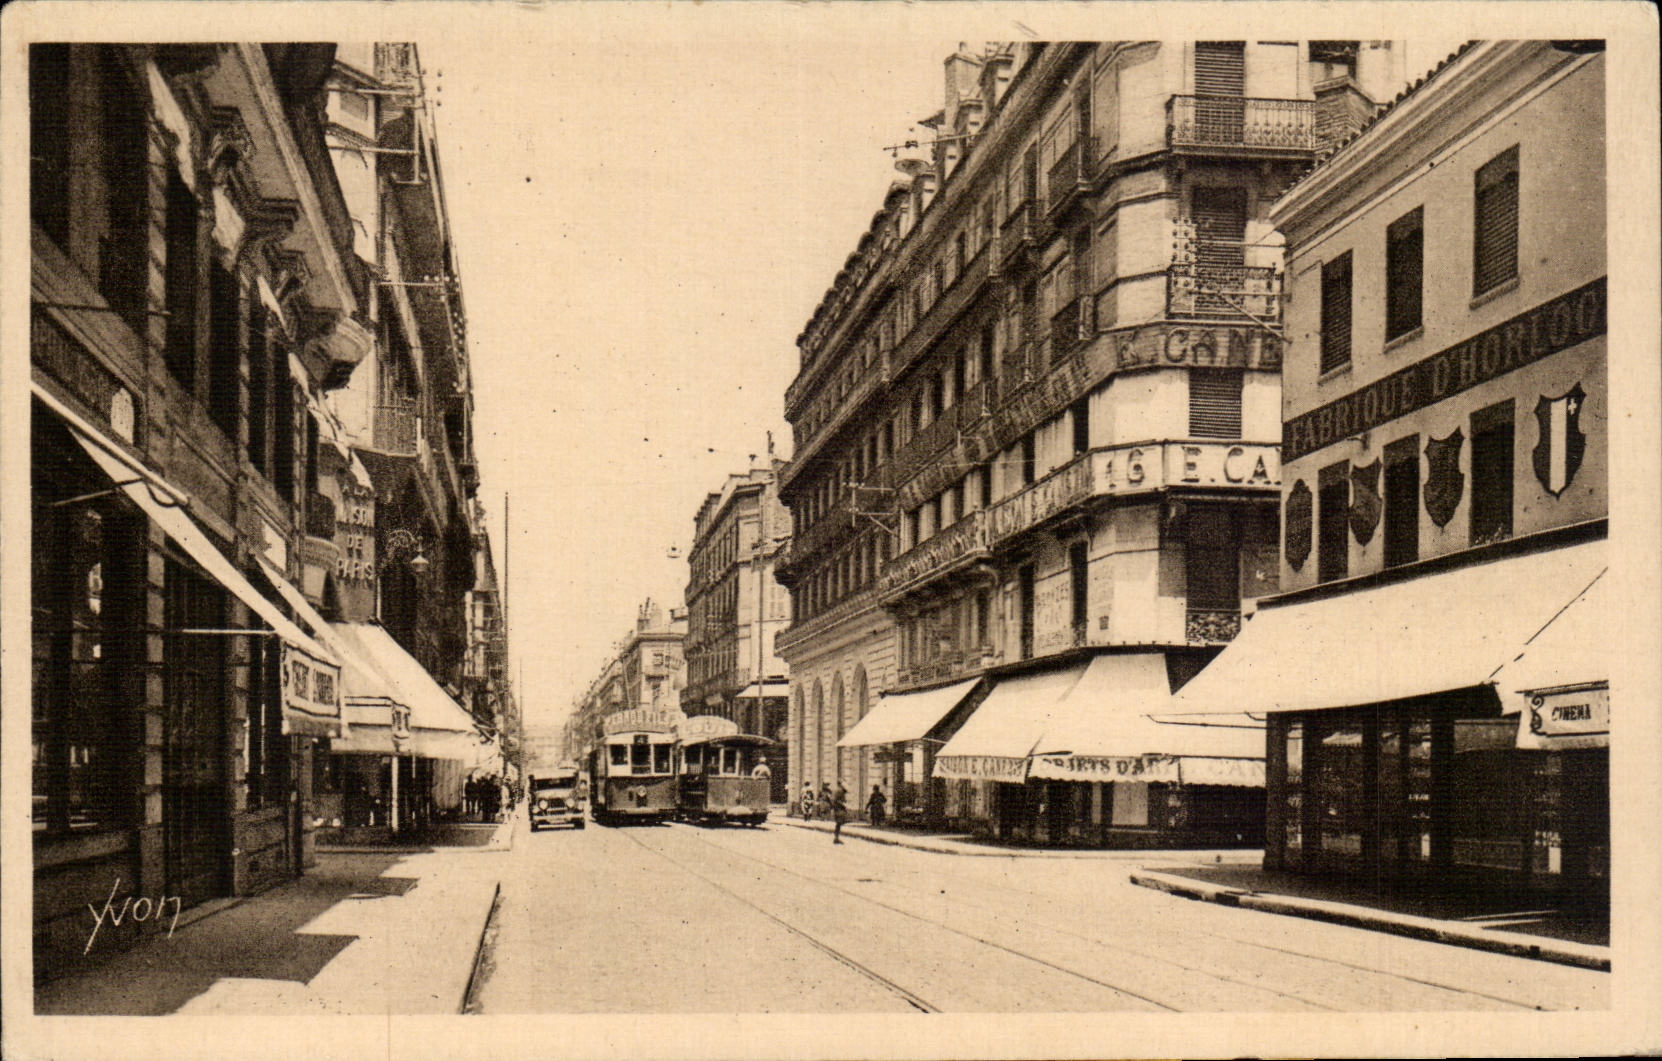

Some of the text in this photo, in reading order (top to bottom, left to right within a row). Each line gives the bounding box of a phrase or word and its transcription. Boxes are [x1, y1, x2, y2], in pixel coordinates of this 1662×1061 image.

[1292, 373, 1415, 454] FABRIQUE
[347, 535, 364, 549] DE
[336, 559, 375, 580] PARIS
